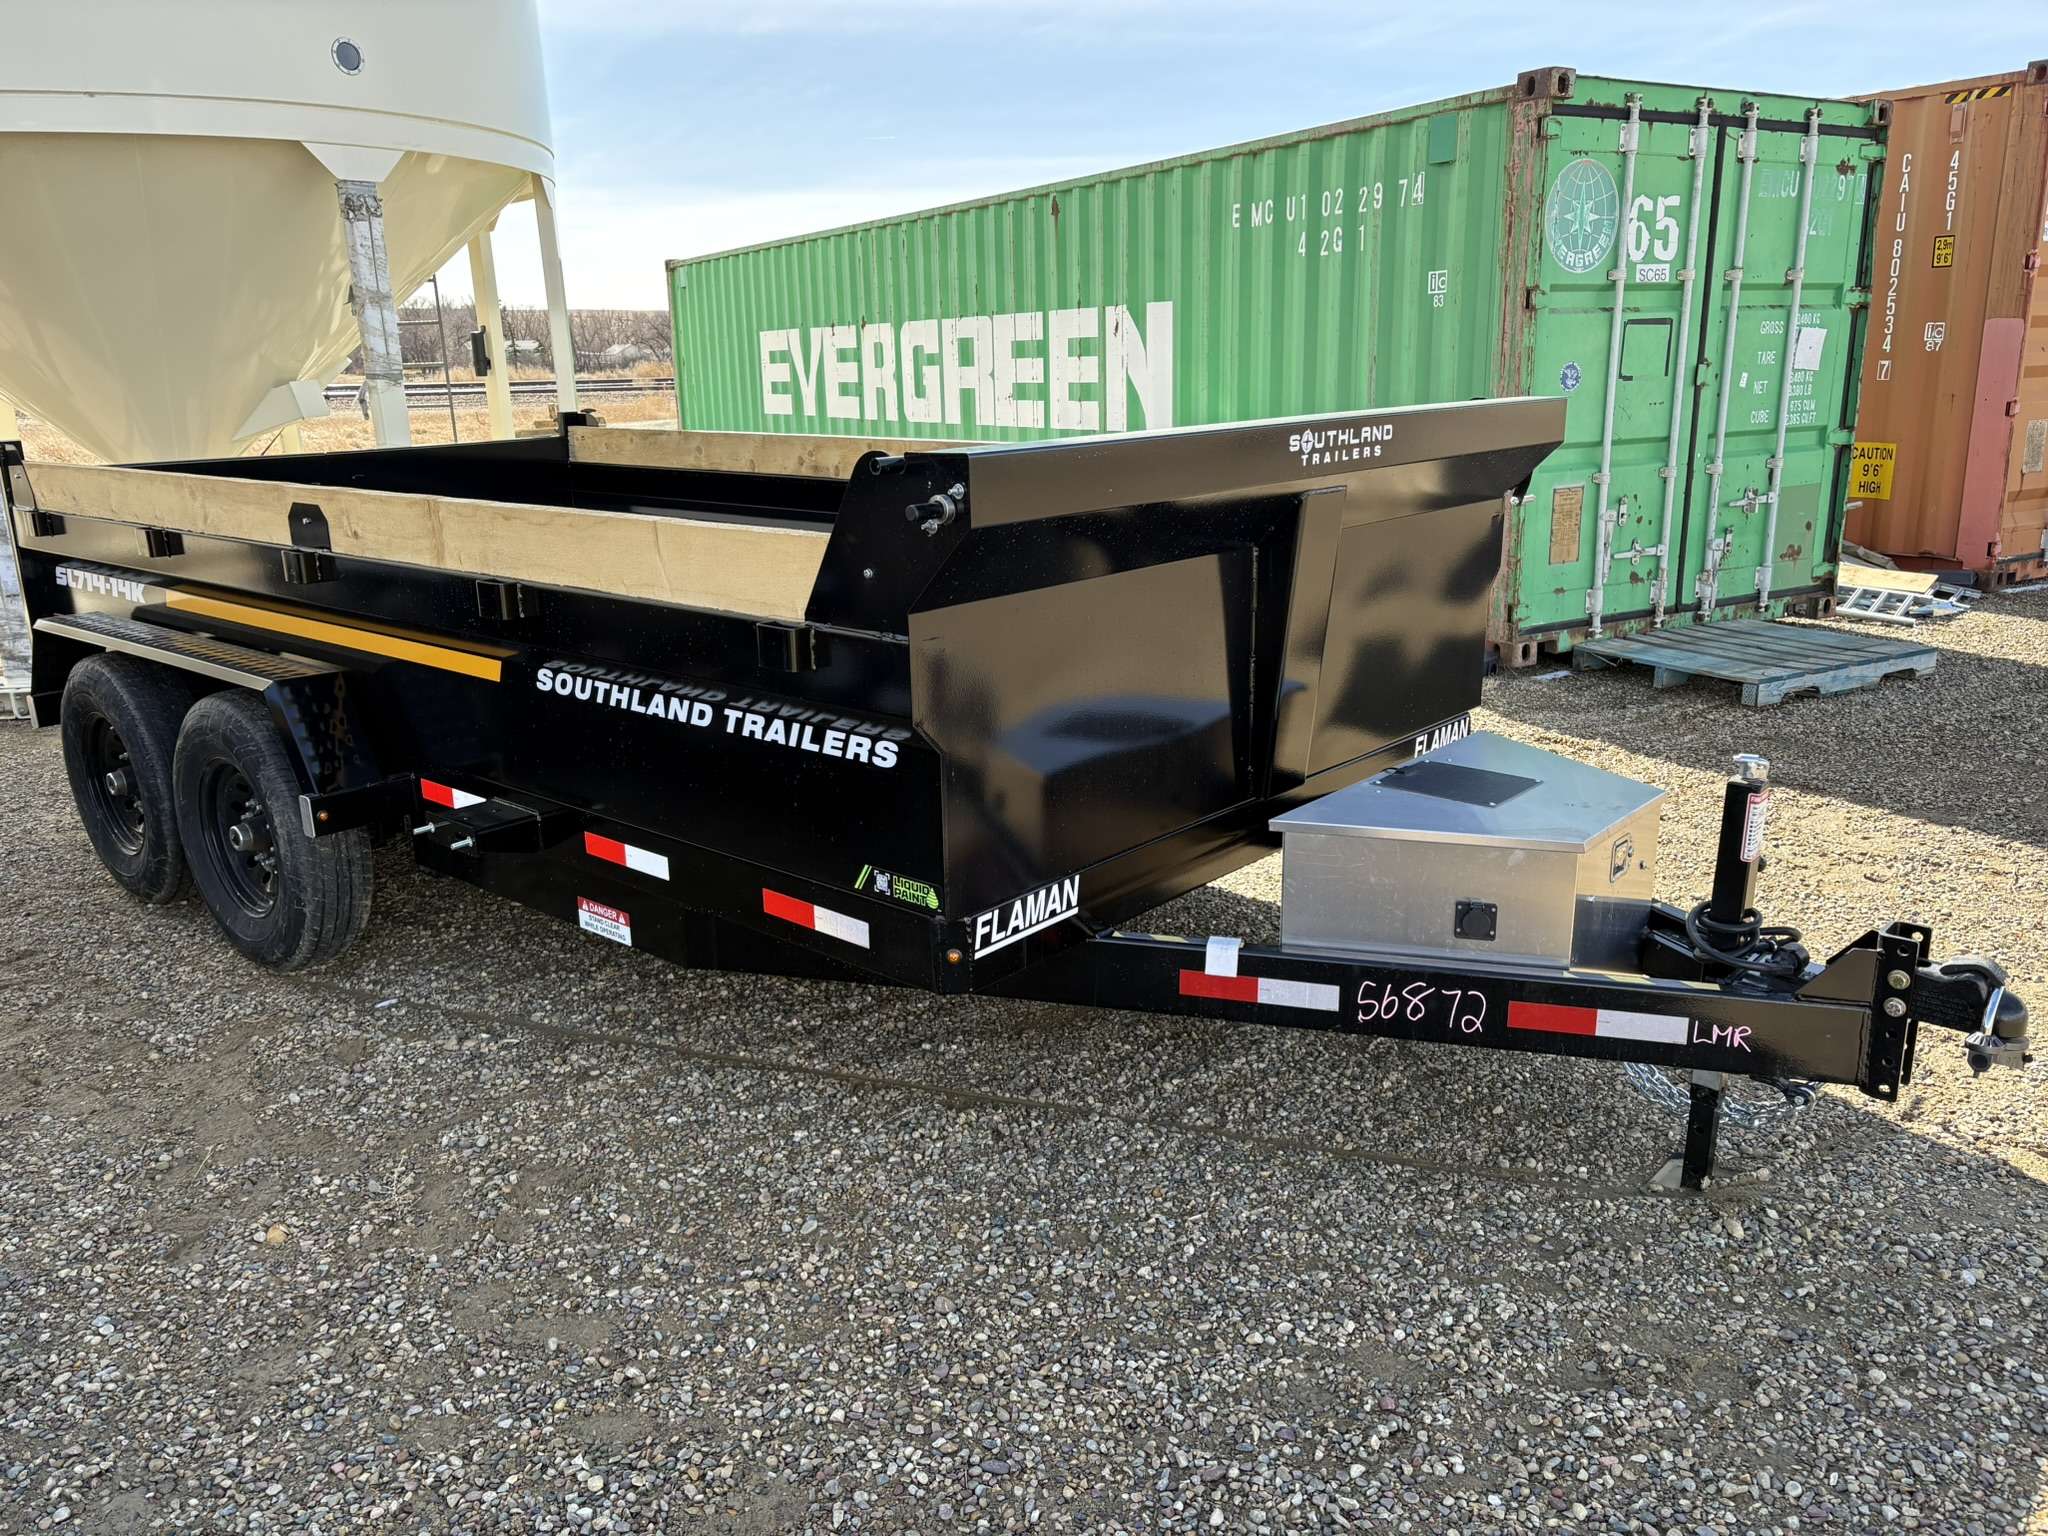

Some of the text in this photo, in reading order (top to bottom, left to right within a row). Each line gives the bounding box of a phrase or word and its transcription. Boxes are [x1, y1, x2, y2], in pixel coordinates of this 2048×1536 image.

[1627, 194, 1681, 263] 65
[1639, 268, 1668, 282] SC65
[1433, 295, 1444, 308] 83
[1760, 321, 1784, 334] GROSS
[1925, 341, 1942, 352] 87
[760, 301, 1173, 433] EVERGREEN
[1757, 351, 1777, 364] TARE
[1753, 381, 1768, 394] NET
[1751, 410, 1770, 423] CUBE
[1289, 424, 1393, 454] SOUTHLAND
[1301, 445, 1382, 466] TRAILERS
[1852, 446, 1894, 460] CAUTION
[1858, 481, 1881, 494] HIGH
[536, 667, 900, 769] SOUTHLAND TRAILERS
[1414, 716, 1470, 759] FLAMAN
[893, 875, 930, 896] LIQUID
[893, 887, 928, 907] PAINT
[589, 902, 618, 921] DANGER
[974, 874, 1080, 951] FLAMAN
[1692, 1020, 1752, 1053] LMR
